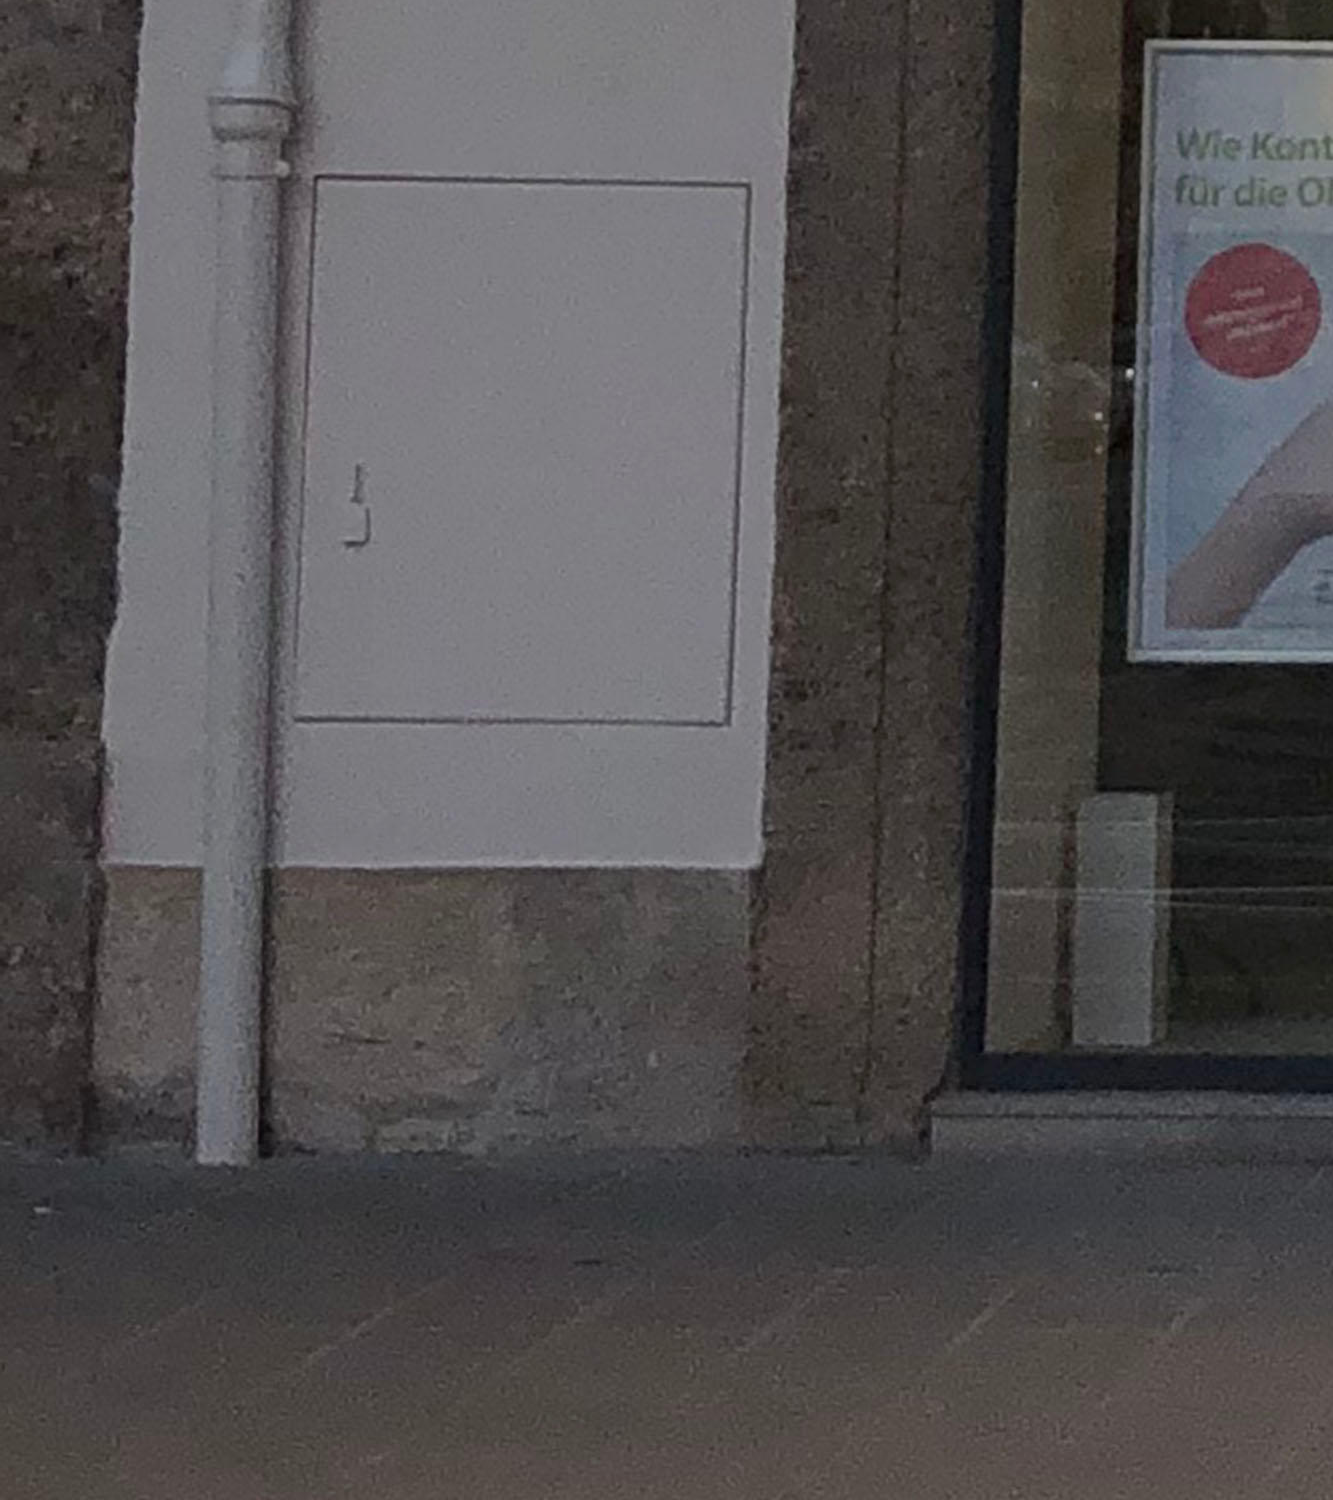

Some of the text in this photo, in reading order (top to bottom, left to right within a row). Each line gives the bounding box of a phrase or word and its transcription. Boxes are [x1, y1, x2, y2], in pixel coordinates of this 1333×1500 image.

[1176, 128, 1242, 161] Wie
[1173, 174, 1225, 208] für
[1235, 177, 1288, 208] die
